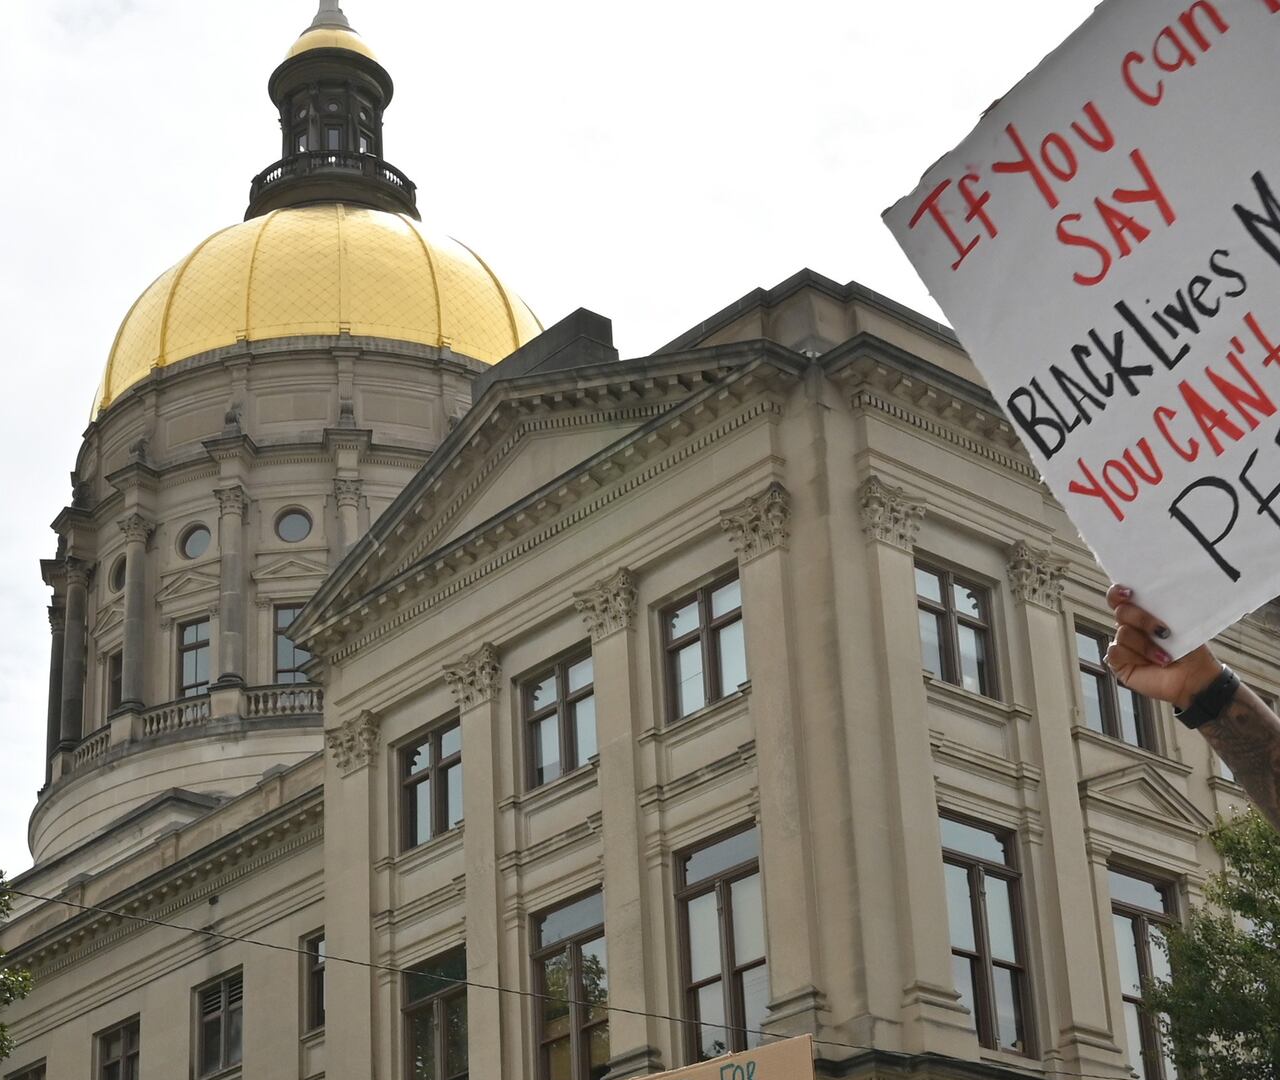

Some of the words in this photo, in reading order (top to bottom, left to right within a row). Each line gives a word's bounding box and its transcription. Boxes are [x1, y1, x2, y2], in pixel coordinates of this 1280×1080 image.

[908, 172, 998, 271] If
[991, 100, 1115, 209] You
[1055, 148, 1177, 286] SAY
[1006, 328, 1154, 460] BLACK
